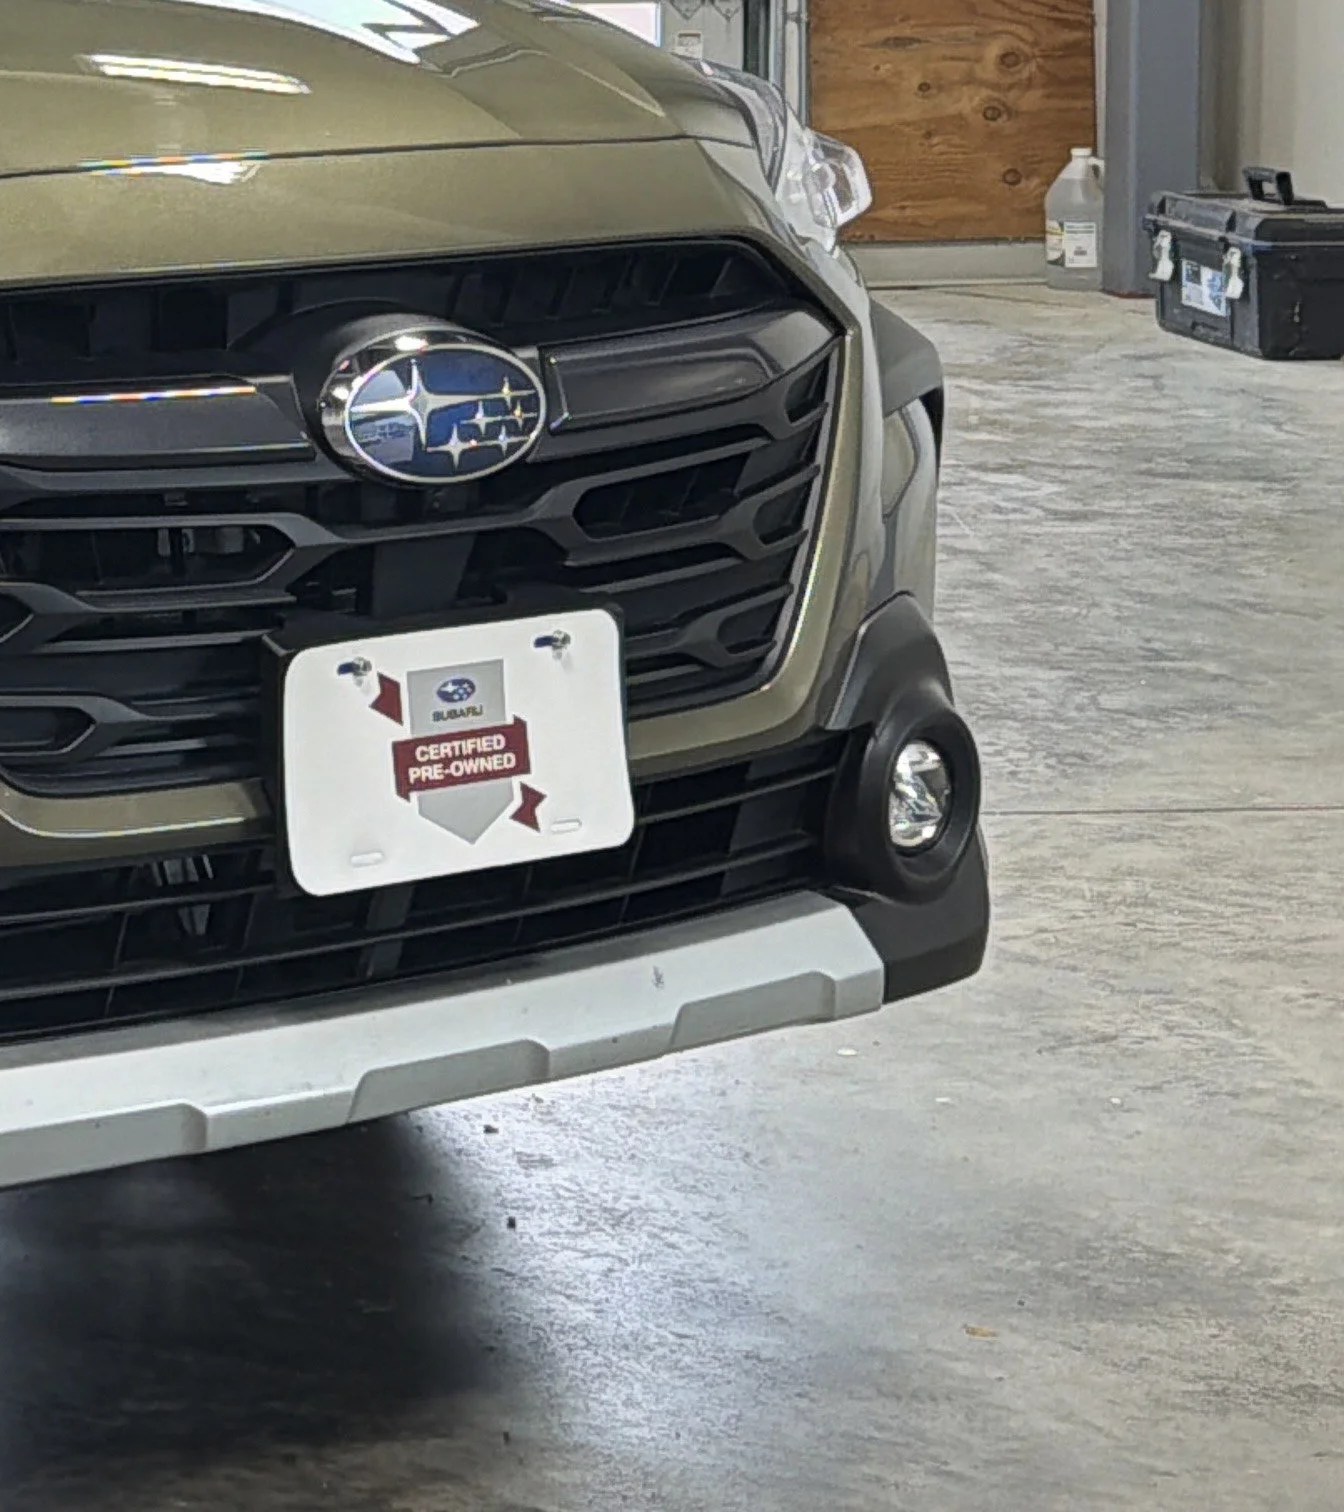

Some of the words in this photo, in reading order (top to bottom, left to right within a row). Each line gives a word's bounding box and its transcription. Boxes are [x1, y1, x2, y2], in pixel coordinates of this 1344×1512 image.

[431, 704, 484, 723] SUBARU
[414, 733, 506, 763] CERTIFIED
[408, 752, 516, 785] PRE-OWNED
